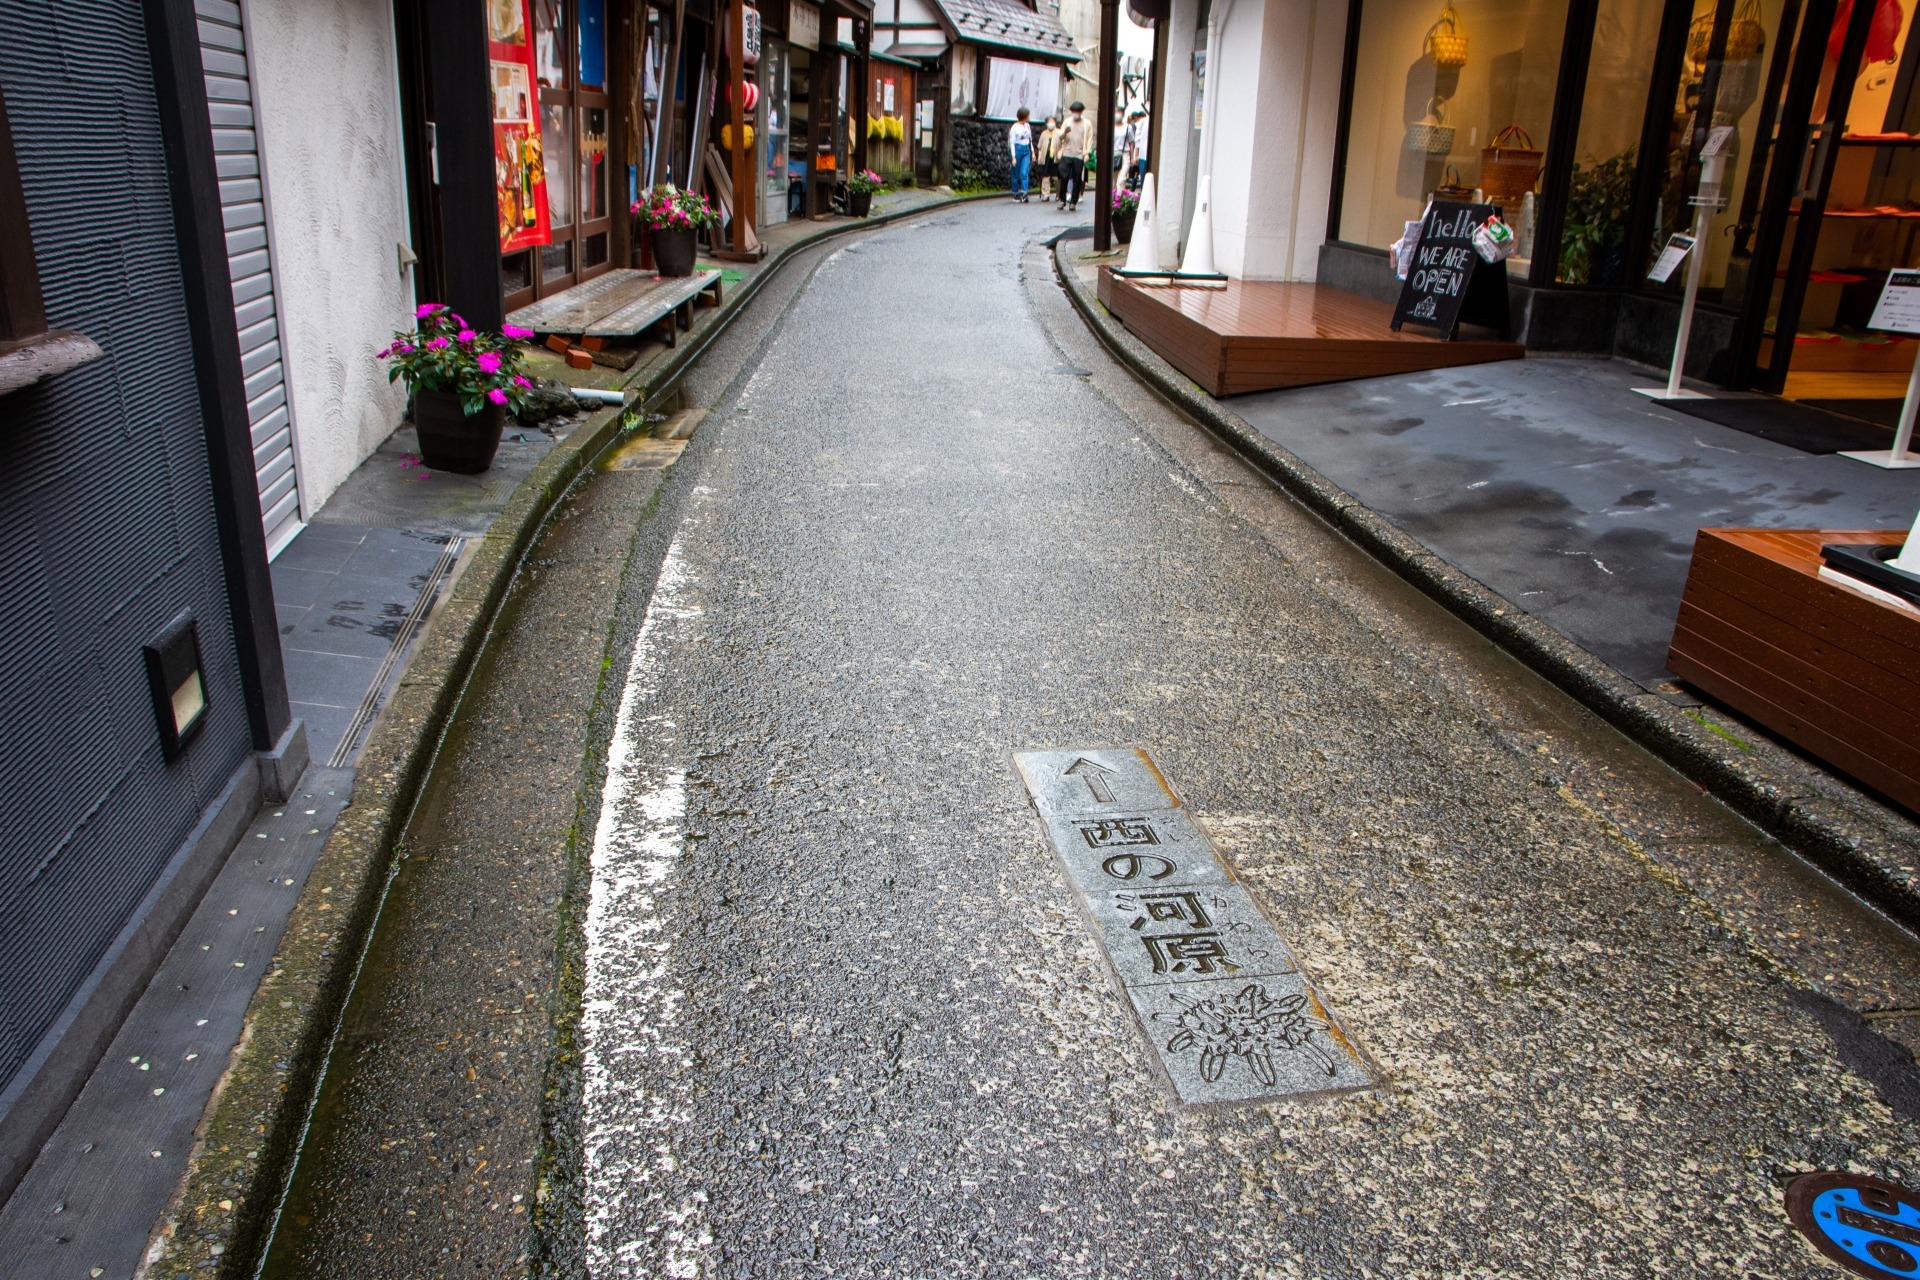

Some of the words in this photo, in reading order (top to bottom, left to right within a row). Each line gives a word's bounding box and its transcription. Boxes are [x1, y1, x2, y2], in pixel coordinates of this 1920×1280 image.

[1426, 210, 1476, 239] hello
[1419, 245, 1443, 266] WE
[1440, 246, 1471, 270] ARE
[1412, 268, 1463, 297] OPEN
[1071, 817, 1244, 975] 西の河原
